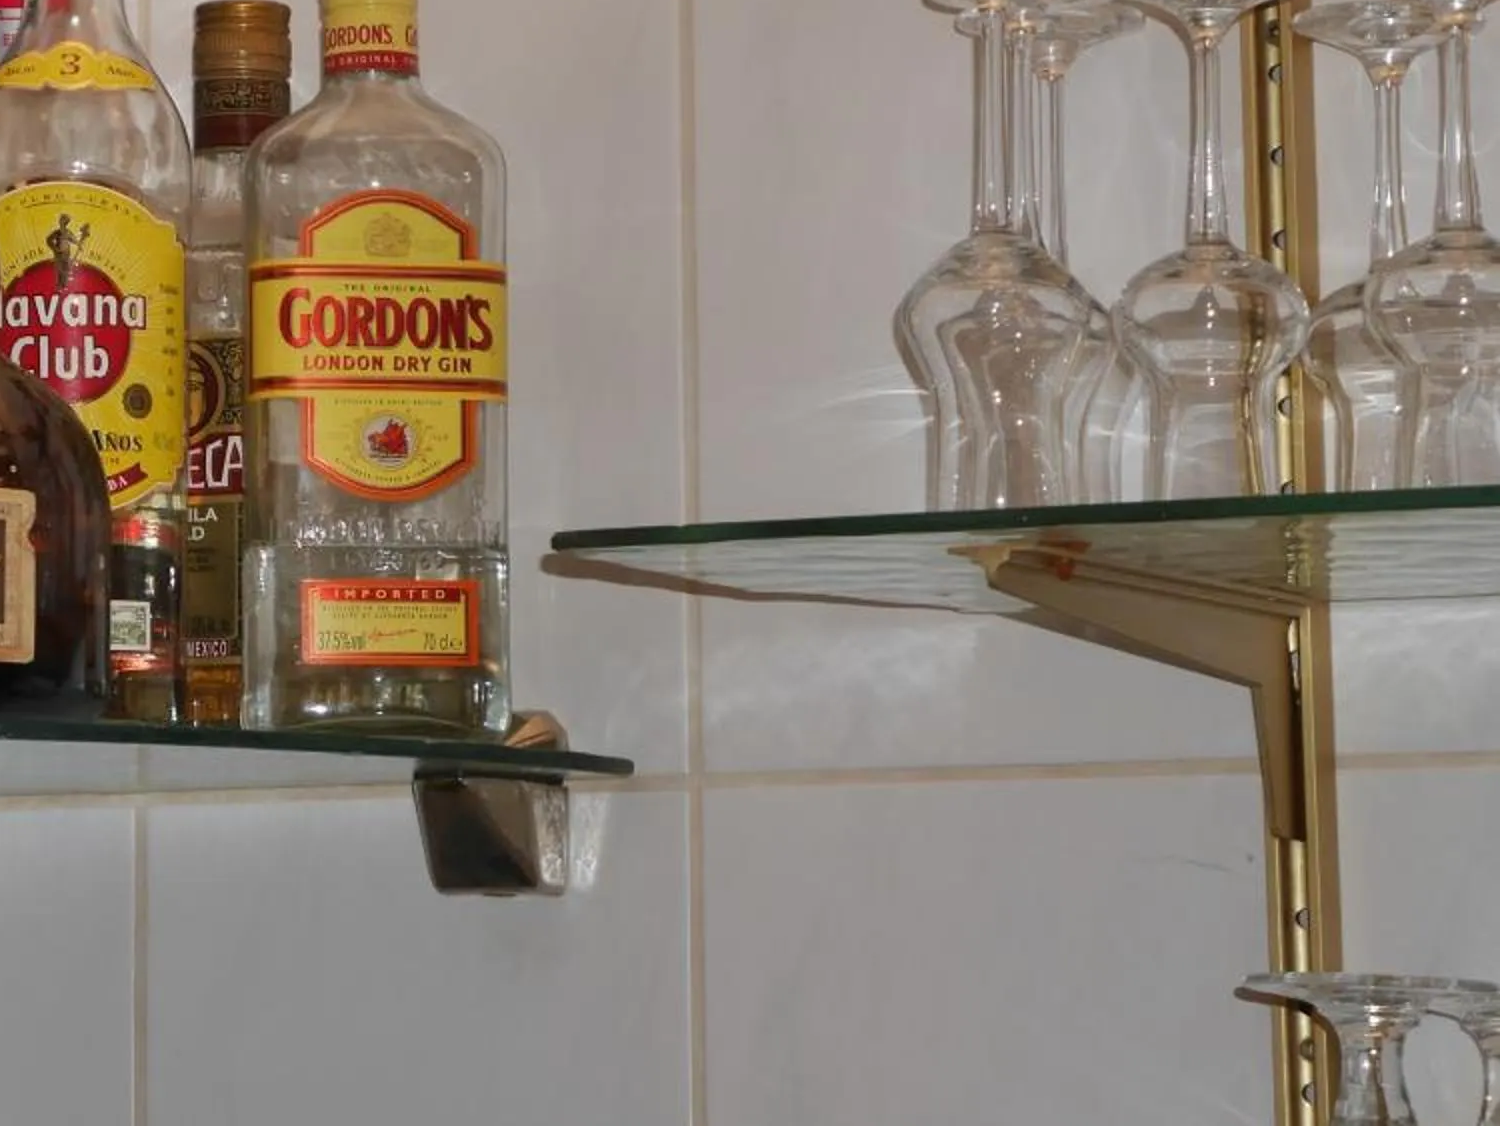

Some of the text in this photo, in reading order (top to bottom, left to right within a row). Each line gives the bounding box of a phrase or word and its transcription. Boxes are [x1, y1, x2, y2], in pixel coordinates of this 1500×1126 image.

[59, 53, 82, 76] 3
[279, 286, 494, 351] GORDON'S
[10, 336, 110, 379] Club
[303, 355, 472, 374] LONDON DRY GIN
[334, 588, 446, 600] IMPORTED
